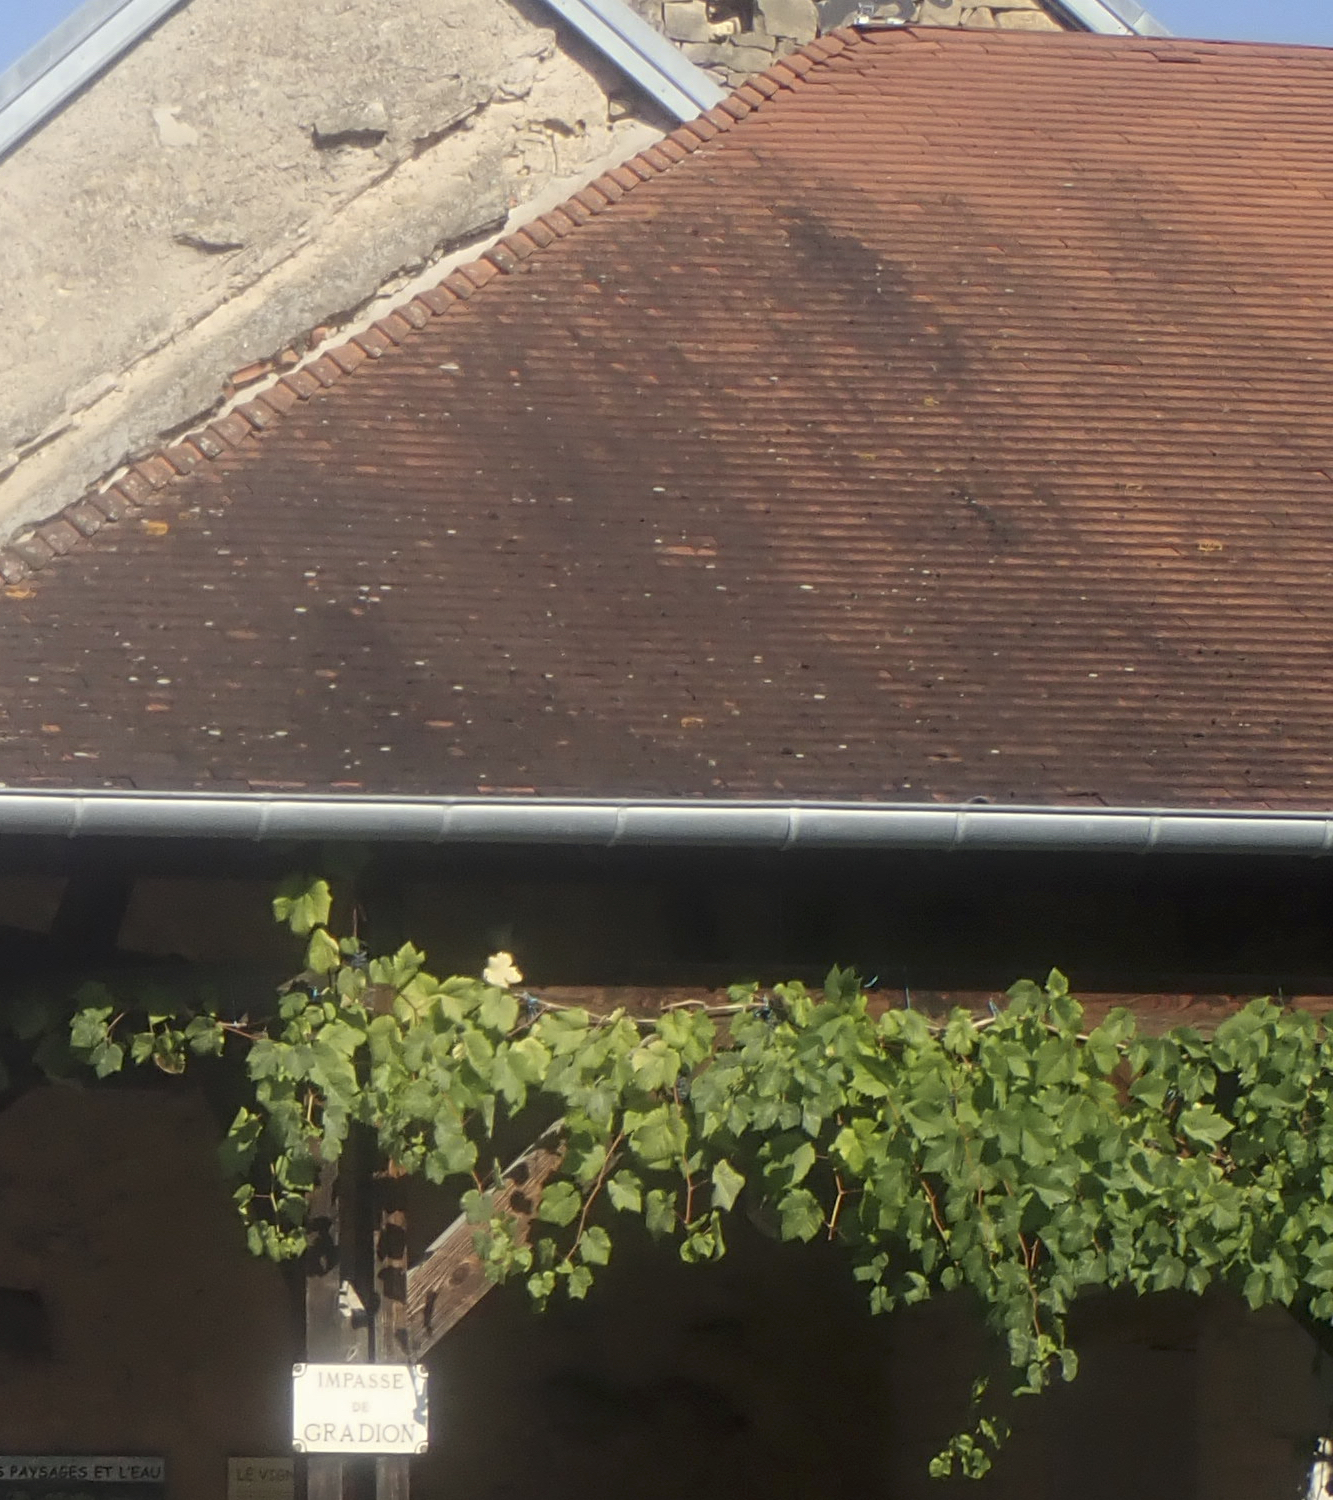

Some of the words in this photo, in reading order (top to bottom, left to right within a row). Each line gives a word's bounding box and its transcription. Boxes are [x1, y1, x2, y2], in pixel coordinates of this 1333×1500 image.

[318, 1372, 404, 1389] IMPASSE
[352, 1401, 370, 1413] DE
[304, 1423, 416, 1443] GRADION
[10, 1465, 89, 1479] PAYSAGES
[94, 1465, 113, 1479] ET
[118, 1465, 162, 1479] L'EAU
